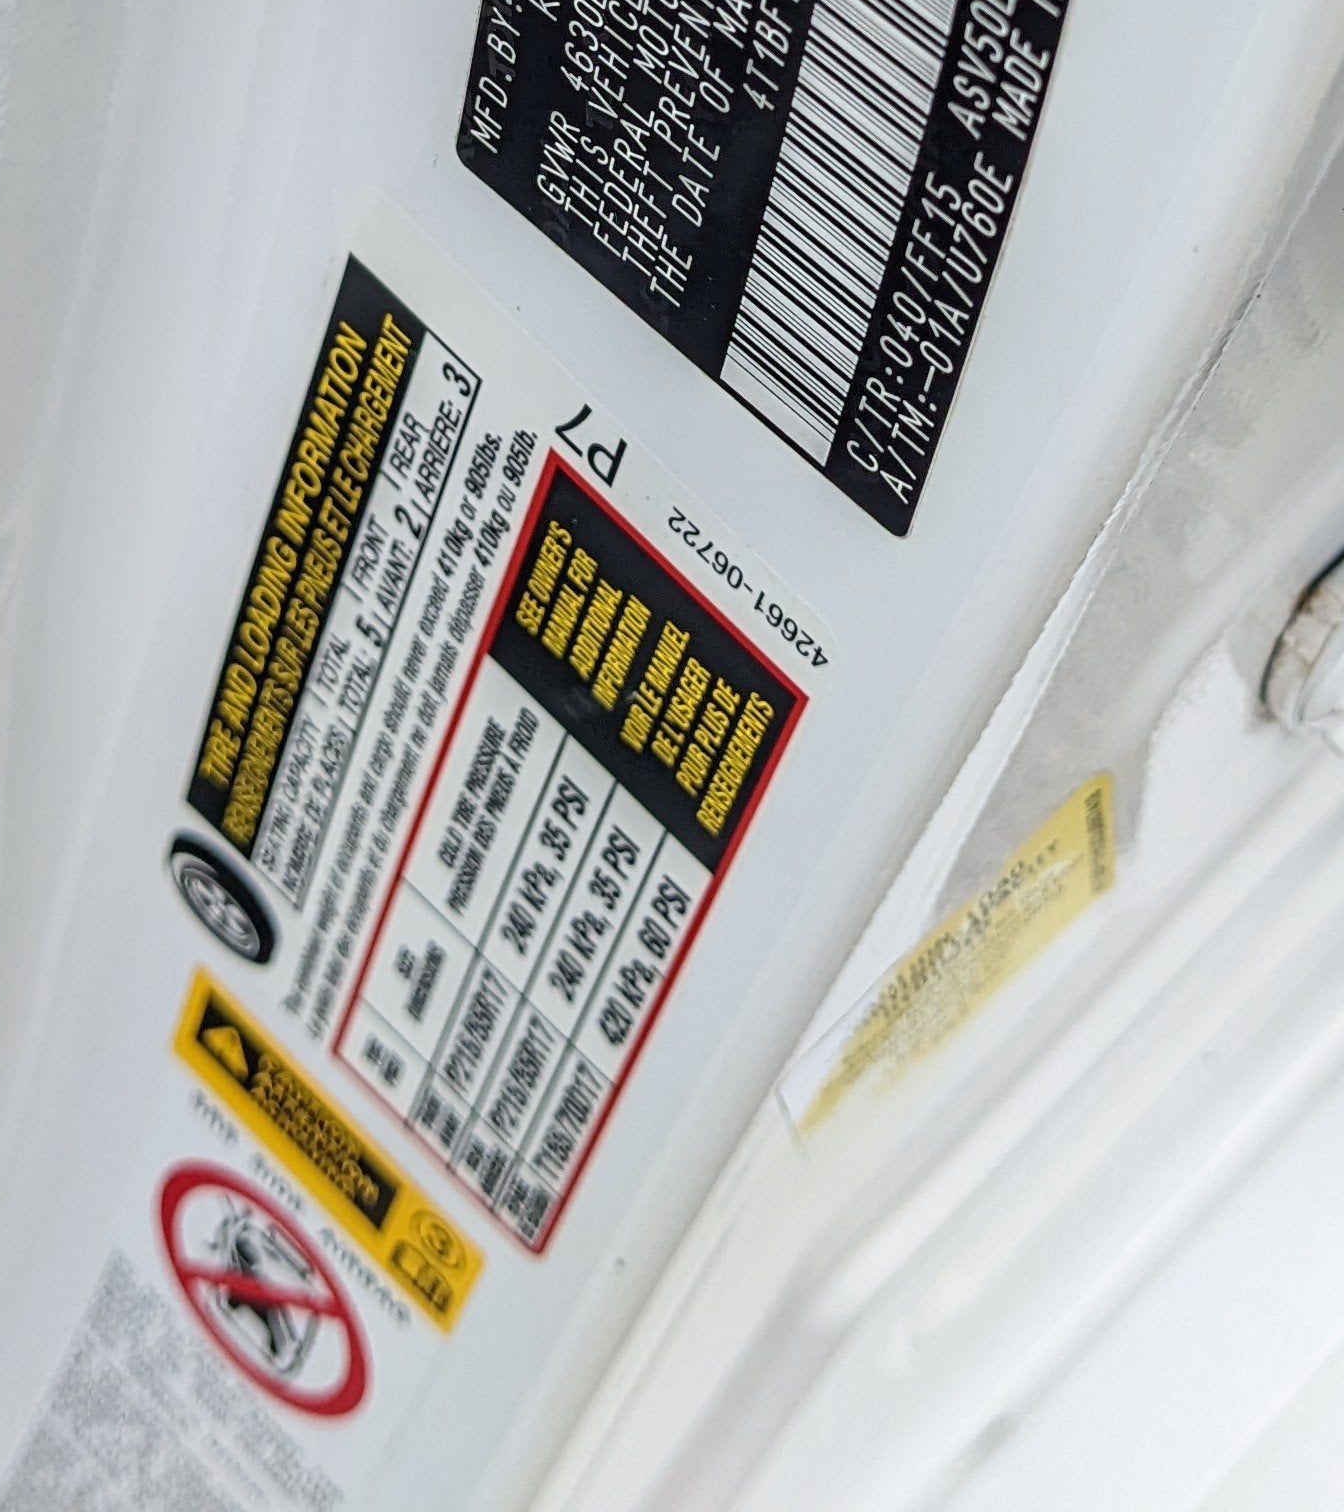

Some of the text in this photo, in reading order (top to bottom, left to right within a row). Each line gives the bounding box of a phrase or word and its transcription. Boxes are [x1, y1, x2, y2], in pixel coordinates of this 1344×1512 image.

[697, 53, 734, 113] OF
[993, 26, 1051, 141] MADE
[534, 109, 583, 204] GVWR
[563, 134, 611, 226] THIS
[592, 101, 655, 257] FEDERAL
[670, 123, 720, 227] DATE
[622, 159, 673, 276] THEFT
[649, 233, 692, 306] THE
[337, 311, 411, 483] CHARGEMENT
[443, 360, 474, 397] 3
[389, 410, 428, 479] REAR
[464, 430, 503, 499] 905lbs.
[506, 431, 538, 487] 905lb.
[555, 402, 629, 488] P7
[319, 495, 353, 545] ET
[329, 464, 364, 514] LE
[394, 501, 422, 538] 2
[457, 494, 479, 522] or
[496, 483, 518, 514] ou
[199, 319, 368, 785] TIRE AND LOADING INFORMATION
[294, 526, 345, 610] PNEUS
[352, 512, 388, 593] FRONT
[435, 519, 471, 578] 410kg
[472, 509, 512, 568] 410kg
[419, 573, 452, 637] exceed
[514, 518, 575, 637] SEE OWNER'S
[540, 545, 600, 659] MANUAL FOR
[667, 505, 829, 669] 42661-06722
[281, 595, 322, 655] LES
[354, 612, 386, 649] 5
[568, 576, 624, 682] ADDITIONAL
[589, 592, 653, 711] INFORMATION
[268, 633, 309, 689] SUR
[316, 631, 349, 693] TOTAL
[400, 636, 428, 684] never
[426, 637, 460, 702] jamais
[619, 618, 692, 754] VOIR LE MANUEL
[380, 674, 414, 738] should
[674, 676, 743, 799] POUR PLUS DE
[463, 714, 508, 799] PRESSURE
[483, 765, 517, 821] PNEUS
[506, 704, 541, 760] FROID
[652, 729, 681, 767] DE
[695, 689, 777, 836] RENSEIGNEMENTS
[549, 772, 592, 831] PSI
[535, 816, 574, 863] 35
[598, 822, 642, 881] PSI
[585, 865, 624, 912] 35
[649, 871, 694, 929] PSI
[498, 900, 538, 956] 240
[634, 914, 676, 960] 60
[547, 949, 588, 1005] 240
[593, 994, 636, 1049] 420
